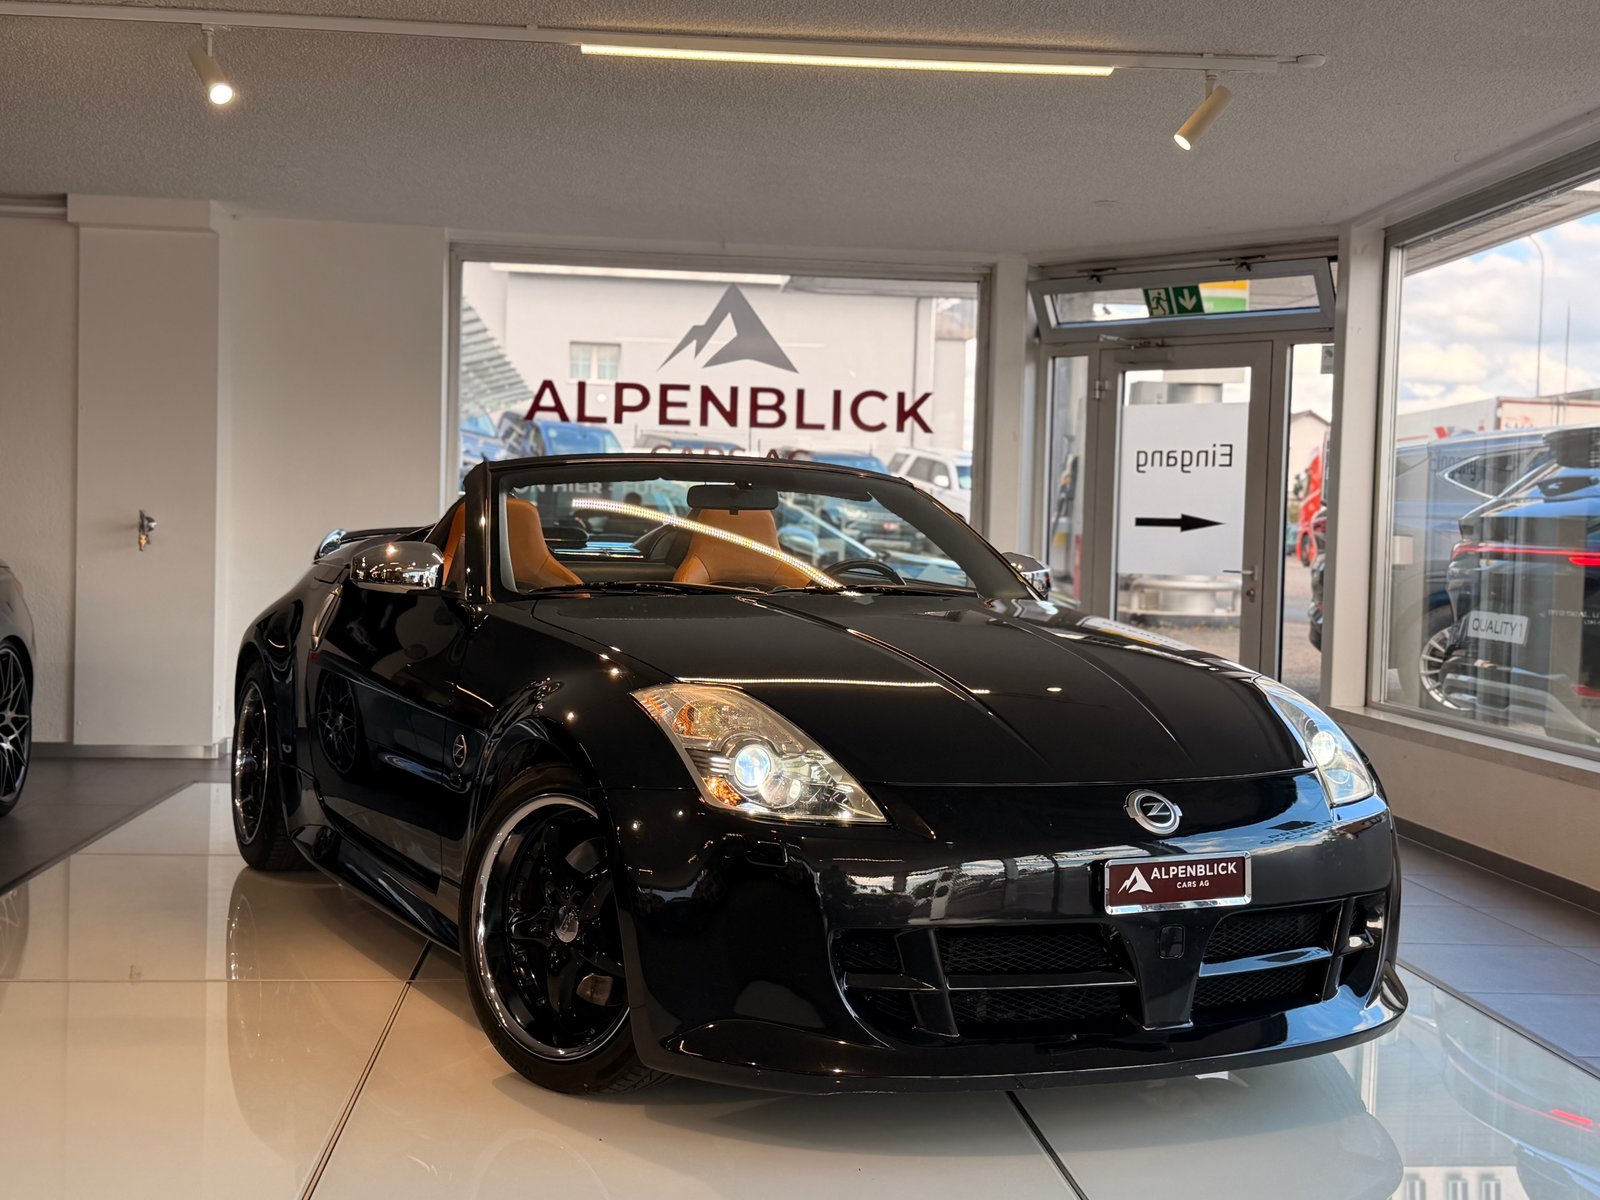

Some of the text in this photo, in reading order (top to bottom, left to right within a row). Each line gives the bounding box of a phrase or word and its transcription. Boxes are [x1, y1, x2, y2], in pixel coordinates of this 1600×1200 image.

[526, 379, 935, 434] ALPENBLICK
[1150, 861, 1237, 880] ALPENBLICK
[1176, 879, 1210, 889] CARS AG
